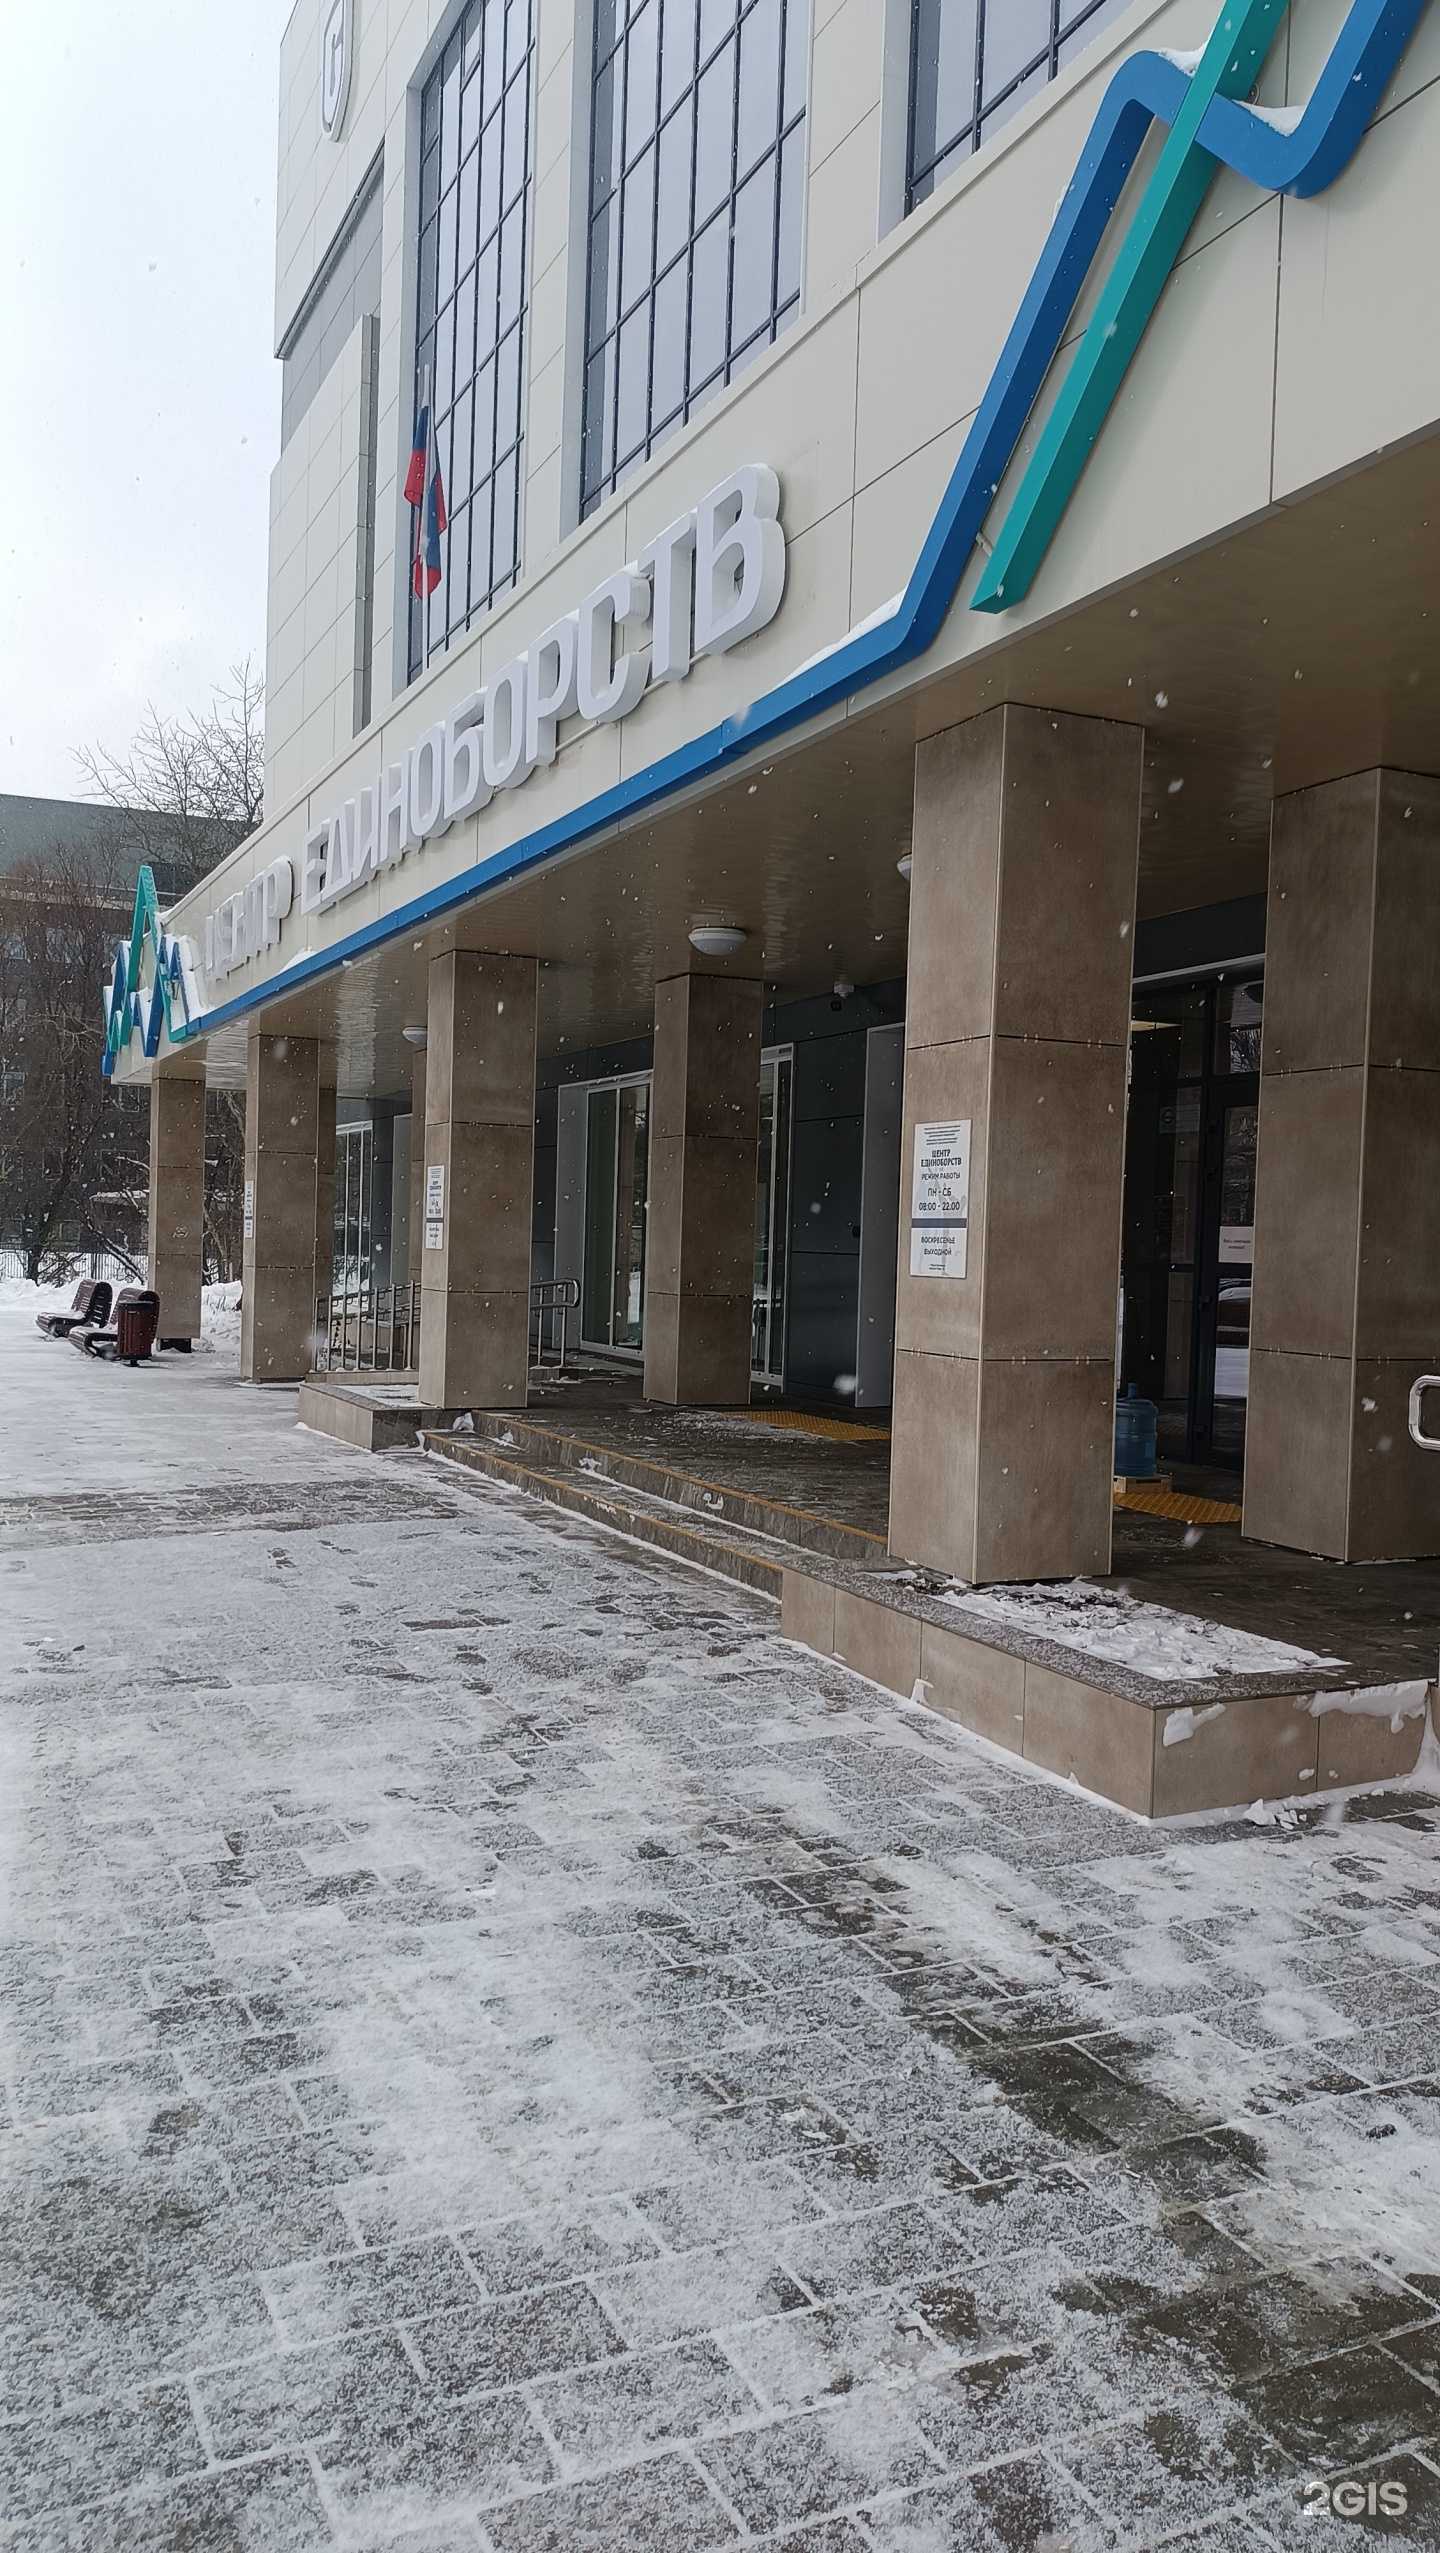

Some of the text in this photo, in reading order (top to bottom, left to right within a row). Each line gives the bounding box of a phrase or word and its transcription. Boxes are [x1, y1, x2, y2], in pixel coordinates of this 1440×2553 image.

[205, 463, 787, 980] ЦЕНТР ЕДИНОБОРСТВ
[931, 1149, 951, 1158] ЦЕНТР
[920, 1157, 962, 1168] ЕДИНОБОРСТВ
[921, 1172, 961, 1181] РЕЖИМ РАБОТЫ
[928, 1187, 937, 1197] ПН
[942, 1187, 952, 1197] СБ
[921, 1236, 956, 1244] ВОСКРЕСЕНЬЕ
[923, 1248, 952, 1256] ВЫХОДНОЙ
